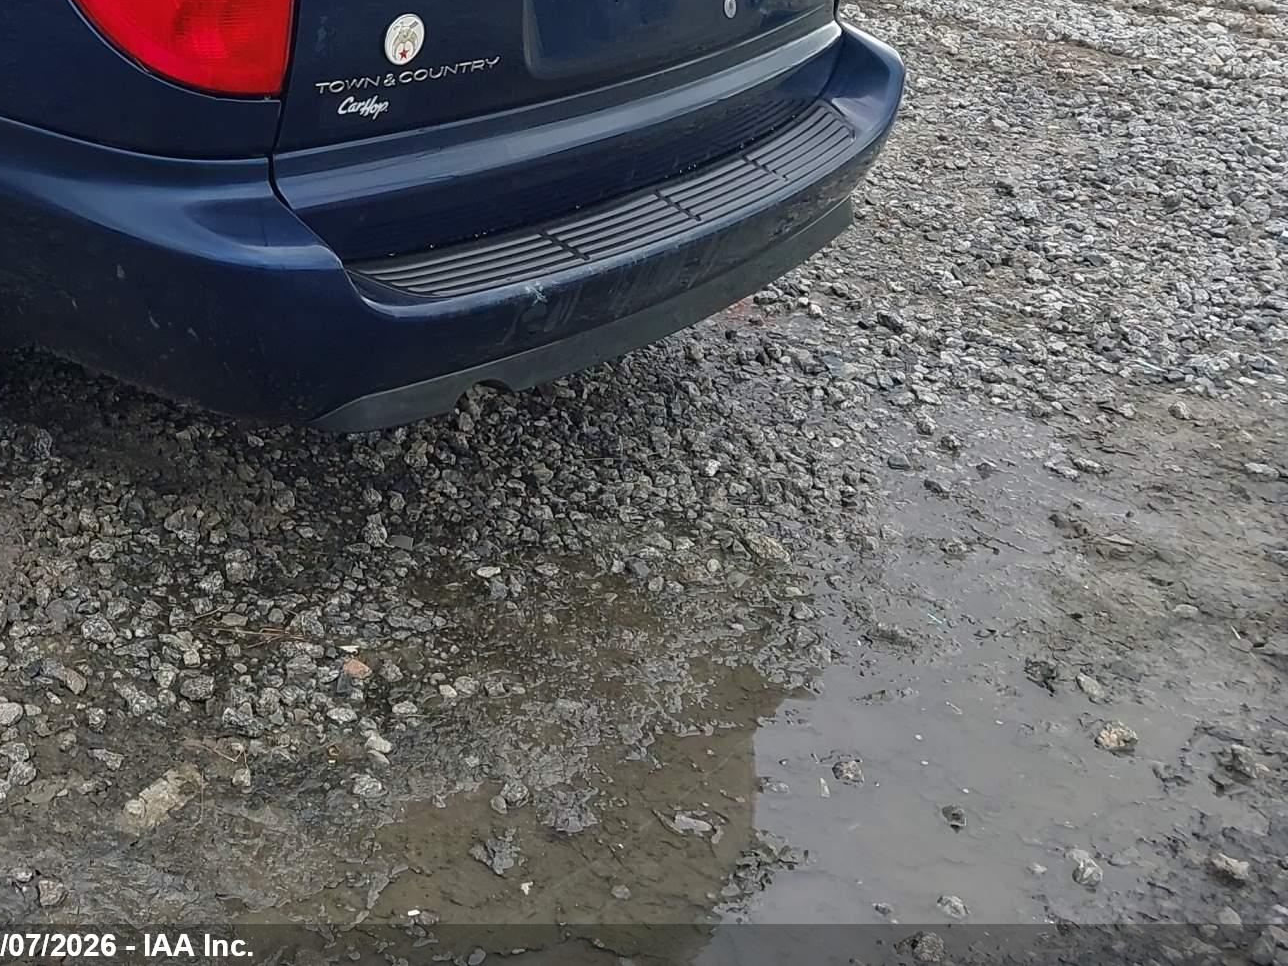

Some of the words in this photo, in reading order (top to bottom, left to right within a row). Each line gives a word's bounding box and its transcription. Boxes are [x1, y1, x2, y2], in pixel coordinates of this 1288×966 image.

[315, 75, 381, 95] TOWN
[383, 73, 397, 88] &
[398, 55, 502, 84] COUNTRY
